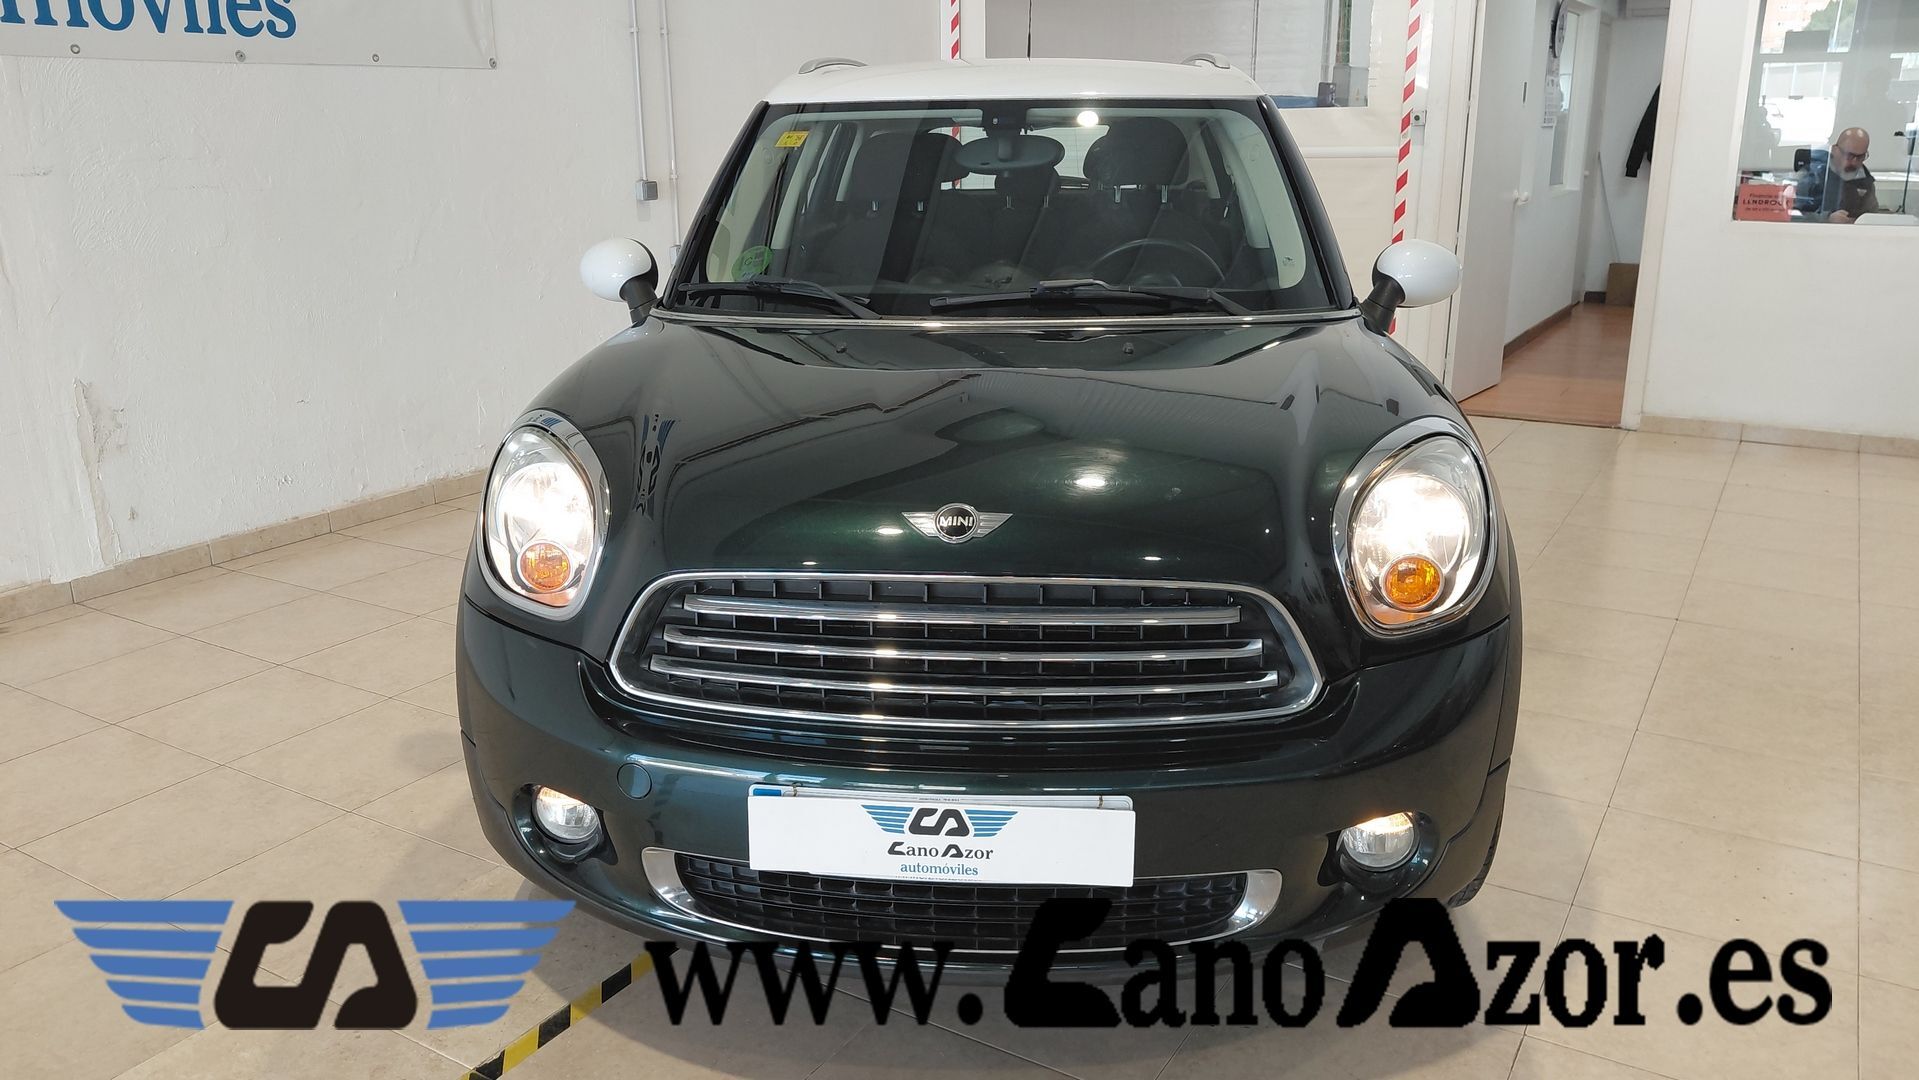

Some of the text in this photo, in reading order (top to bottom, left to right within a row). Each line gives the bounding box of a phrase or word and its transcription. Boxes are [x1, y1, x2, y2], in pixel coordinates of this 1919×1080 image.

[940, 515, 974, 527] MINI
[887, 841, 994, 860] Cano Azor
[900, 862, 979, 876] automóviles
